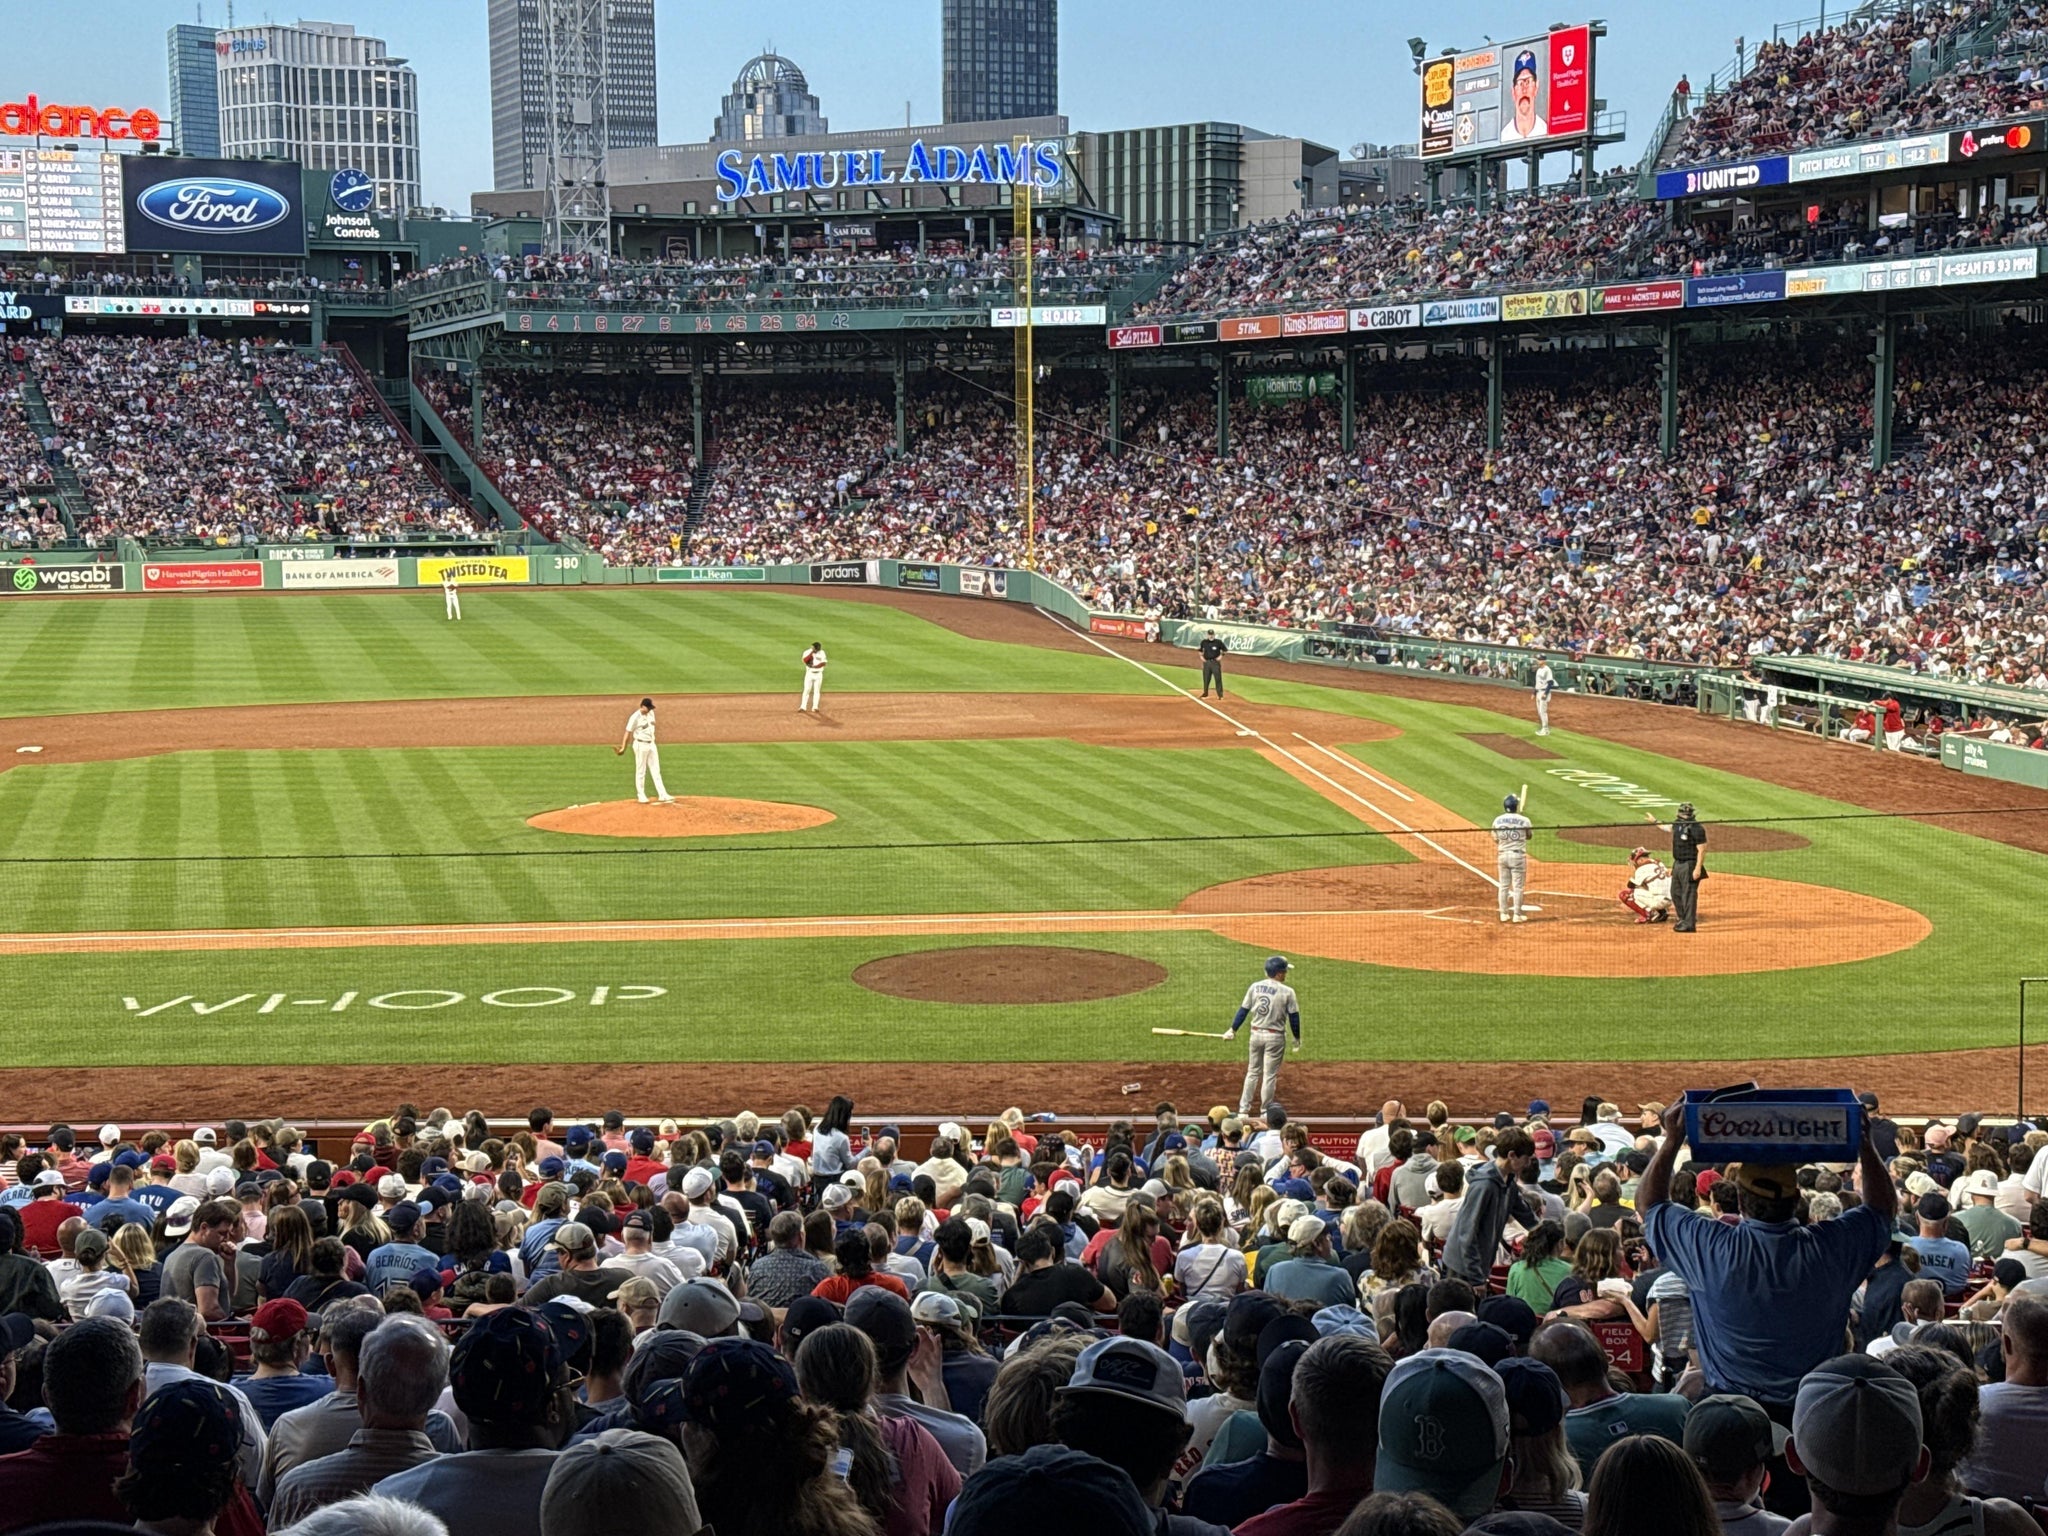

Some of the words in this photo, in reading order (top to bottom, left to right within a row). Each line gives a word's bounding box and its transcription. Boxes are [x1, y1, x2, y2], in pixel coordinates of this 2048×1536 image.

[1980, 134, 2005, 148] prefers
[39, 162, 82, 174] RAFAELA
[715, 148, 895, 202] SAMUEL
[899, 138, 1063, 188] ADAMS
[1800, 159, 1823, 174] PITCH
[1823, 155, 1851, 171] BREAK
[40, 173, 71, 184] ABREU
[1702, 165, 1760, 190] UNITED
[40, 185, 94, 196] CONTRERAS
[41, 197, 72, 207] DURAN
[169, 185, 259, 224] Ford
[42, 208, 81, 218] YOSHIDA
[325, 213, 371, 227] Johnson
[334, 226, 380, 239] Controls
[42, 241, 75, 252] MAYER
[1944, 261, 1981, 277] 4-SEAM
[1997, 258, 2011, 272] 93
[2013, 256, 2033, 271] MPH
[1788, 278, 1827, 293] BENNETT
[1604, 294, 1622, 303] MAKE
[1631, 291, 1661, 302] MONSTER
[1661, 290, 1681, 300] MARG
[1760, 290, 1777, 298] Center
[1447, 301, 1497, 319] CALL128.COM
[519, 314, 532, 331] 9
[547, 314, 559, 331] 4
[572, 315, 582, 331] 1
[595, 315, 608, 332] 8
[622, 315, 646, 332] 27
[658, 316, 672, 332] 6
[695, 315, 712, 332] 14
[725, 315, 748, 331] 45
[759, 314, 783, 330] 26
[795, 313, 817, 330] 34
[831, 312, 850, 329] 42
[1237, 322, 1262, 335] STIHL
[1283, 317, 1308, 334] King's
[1307, 314, 1345, 330] Hawaiian
[1132, 330, 1154, 346] PIZZA
[1266, 380, 1303, 393] HORNITOS
[269, 548, 304, 560] DICK'S
[554, 557, 579, 569] 380
[40, 565, 111, 584] wasabi
[162, 570, 191, 579] Harvard
[191, 569, 217, 578] Pilgrim
[285, 572, 312, 580] BANK
[329, 571, 374, 579] AMERICA
[438, 564, 486, 581] TWISTED
[487, 564, 508, 580] TEA
[1499, 825, 1521, 841] 36
[1255, 984, 1278, 995] STRAW
[122, 986, 669, 1017] WHOOP
[1257, 995, 1271, 1016] 3
[1702, 1111, 1776, 1138] Coors
[1778, 1120, 1843, 1137] LIGHT
[1311, 1137, 1358, 1145] CAUTION
[139, 1194, 164, 1207] RYU
[375, 1253, 419, 1271] BERRÍOS
[1920, 1255, 1956, 1270] ANSEN
[1601, 1328, 1632, 1336] FIELD
[1605, 1337, 1628, 1345] BOX
[1603, 1350, 1633, 1365] 54
[1414, 1415, 1446, 1460] B
